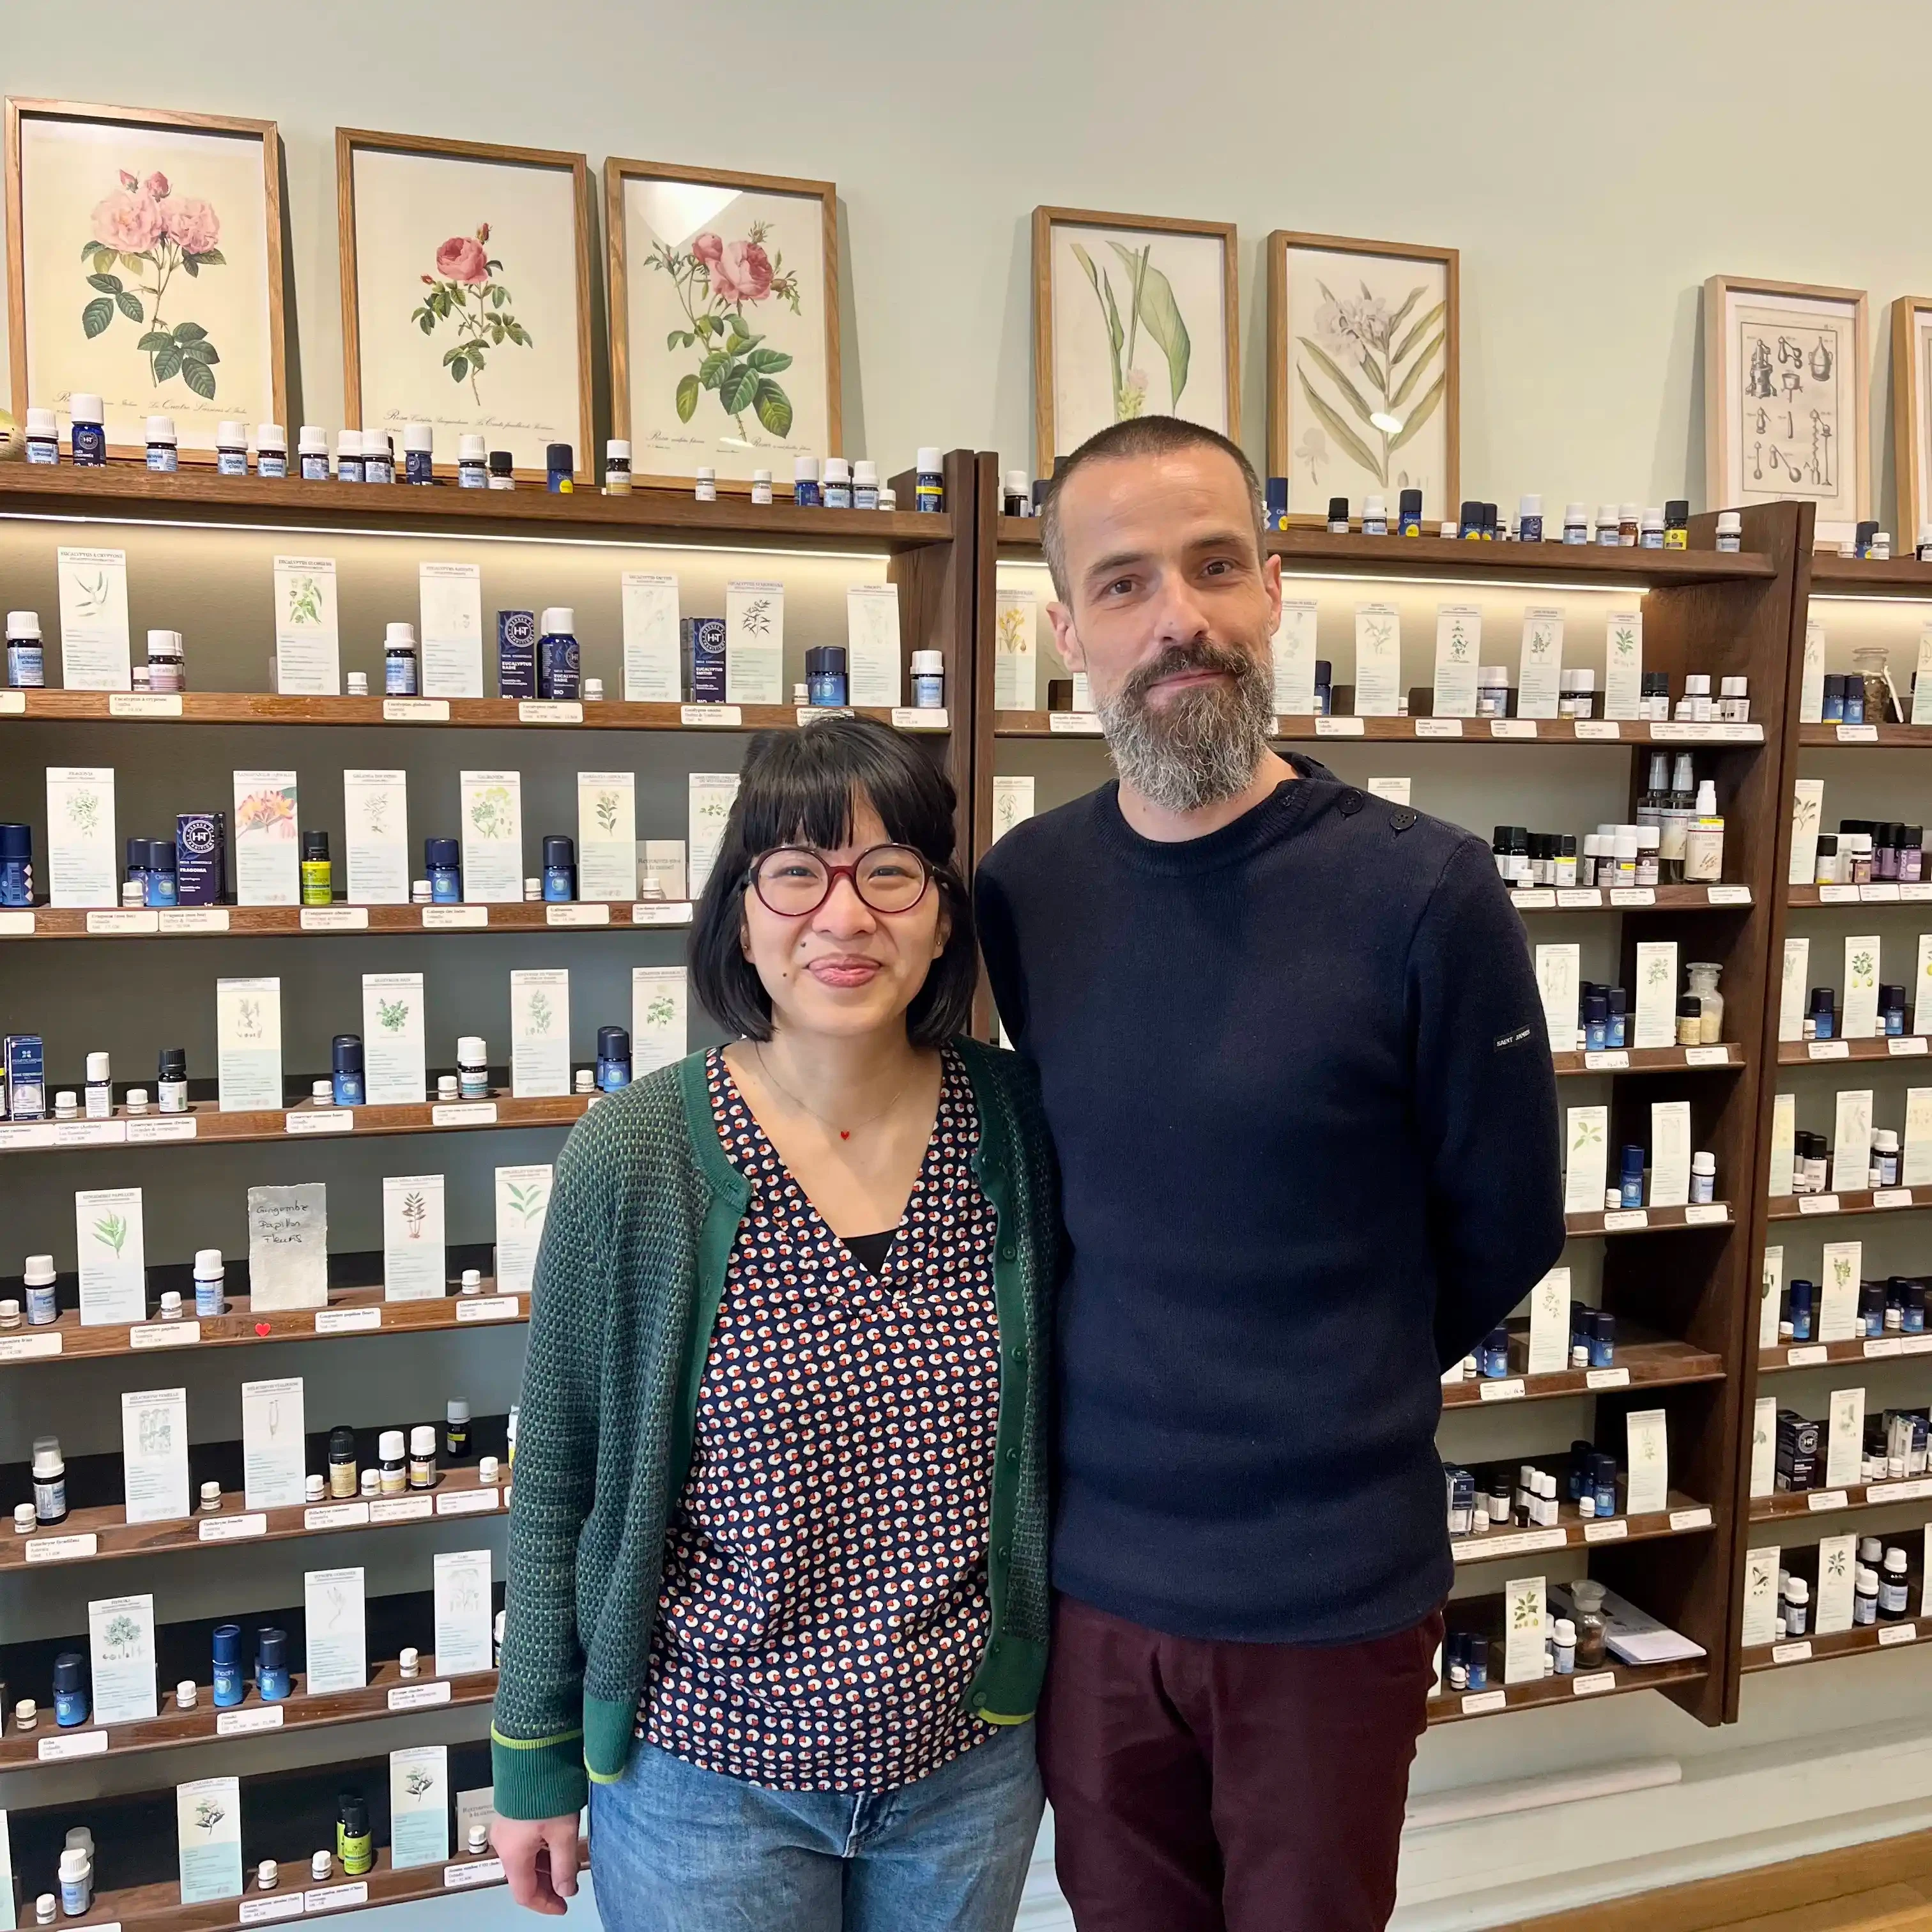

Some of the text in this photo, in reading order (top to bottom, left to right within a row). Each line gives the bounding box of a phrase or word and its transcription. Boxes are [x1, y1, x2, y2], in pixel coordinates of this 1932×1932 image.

[1496, 1029, 1531, 1047] SAINT JAMES
[258, 1218, 300, 1231] Papillon
